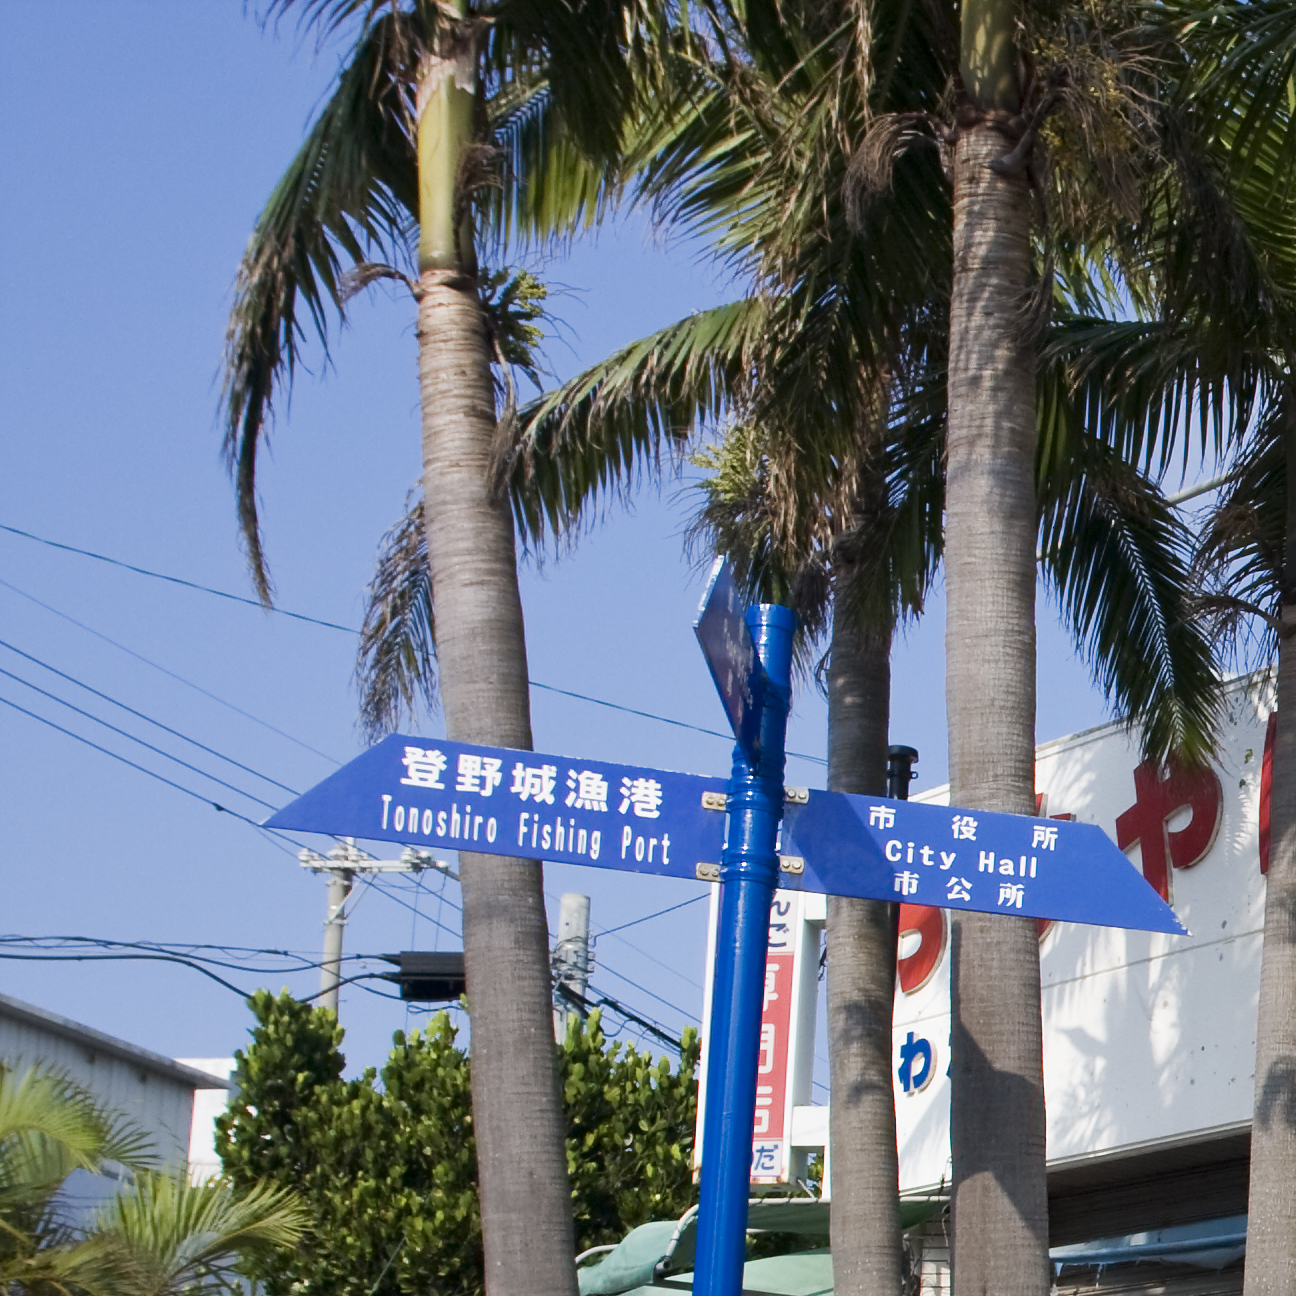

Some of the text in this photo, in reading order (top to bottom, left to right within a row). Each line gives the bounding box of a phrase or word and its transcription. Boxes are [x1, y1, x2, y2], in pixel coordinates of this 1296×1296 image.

[399, 746, 664, 819] 登野城漁港
[380, 793, 671, 865] Tonoshiro Fishing Port
[869, 804, 1059, 851] 市役所
[884, 839, 1038, 879] City Hall
[893, 870, 1026, 909] 市公所
